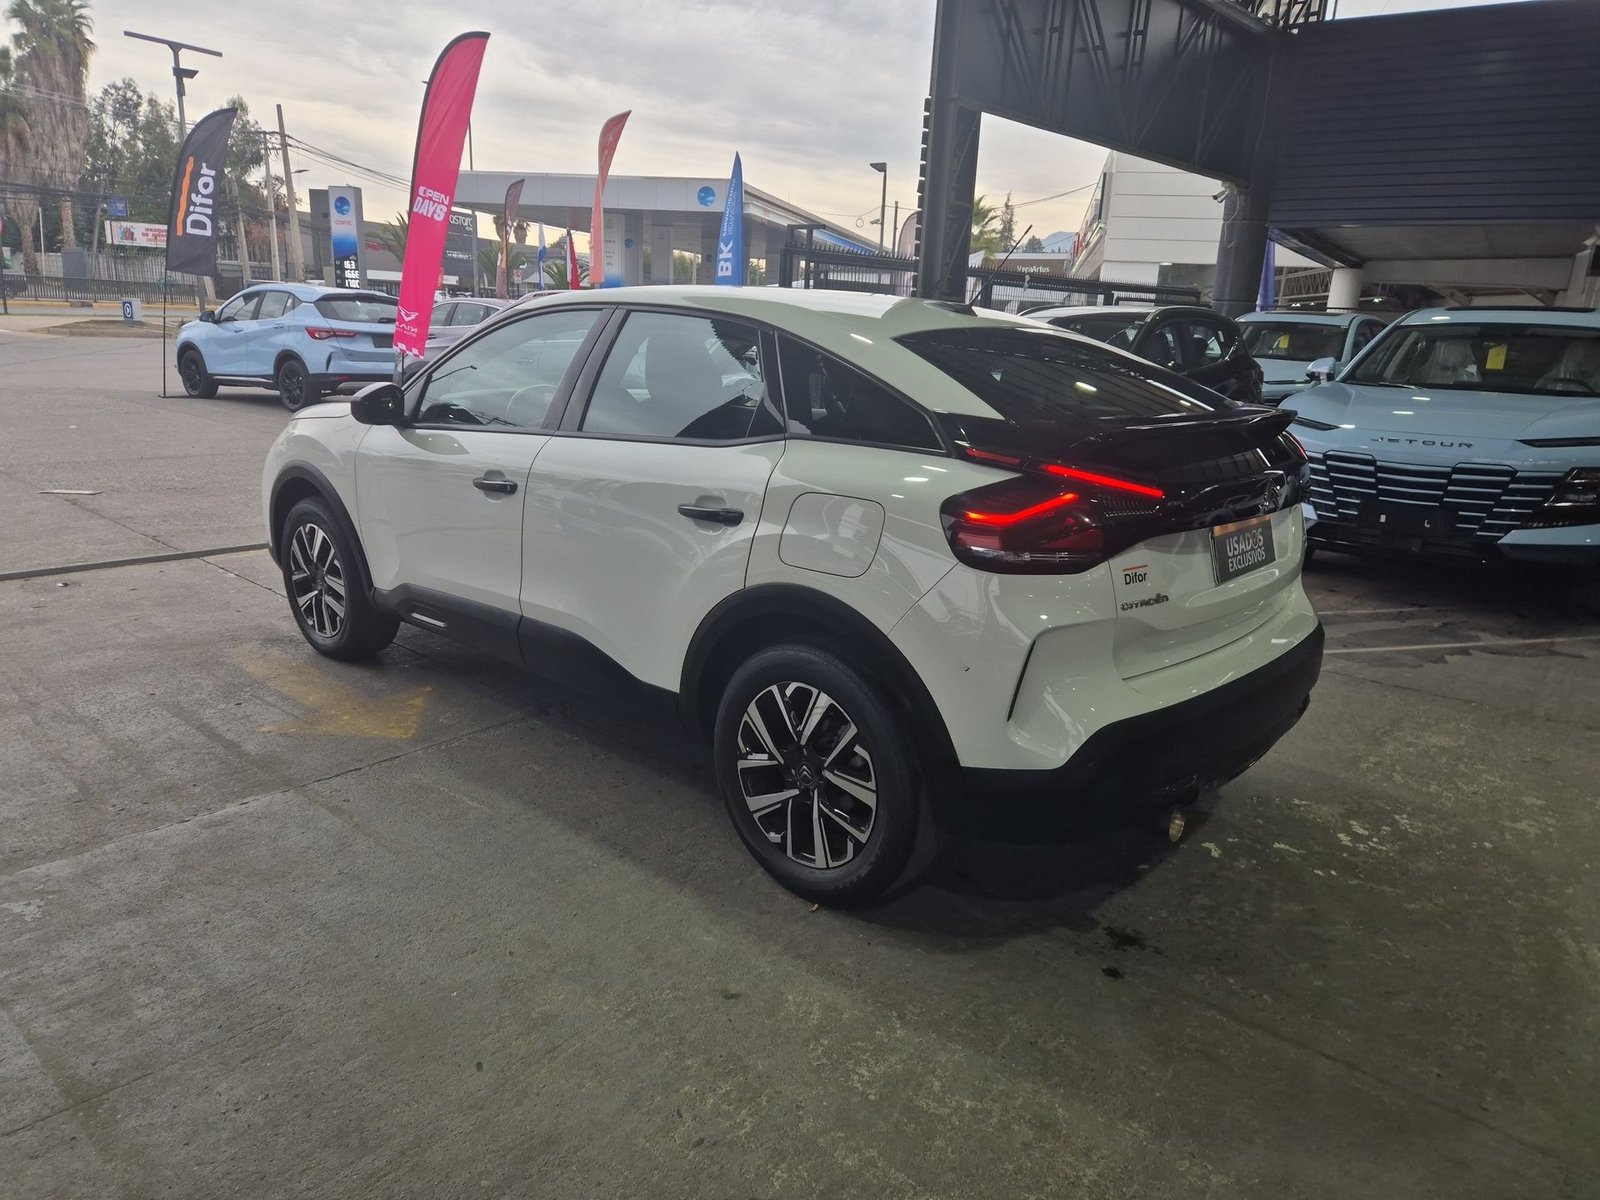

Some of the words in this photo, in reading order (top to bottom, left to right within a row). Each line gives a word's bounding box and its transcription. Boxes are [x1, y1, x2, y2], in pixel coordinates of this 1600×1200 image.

[186, 162, 216, 236] Difor
[418, 185, 450, 206] OPEN
[413, 196, 448, 222] DAYS
[717, 240, 733, 277] BK
[1370, 436, 1473, 449] JETOUR
[1226, 528, 1264, 557] USADOS
[1228, 546, 1266, 573] EXCLUSIVOS
[1124, 571, 1148, 586] Difor
